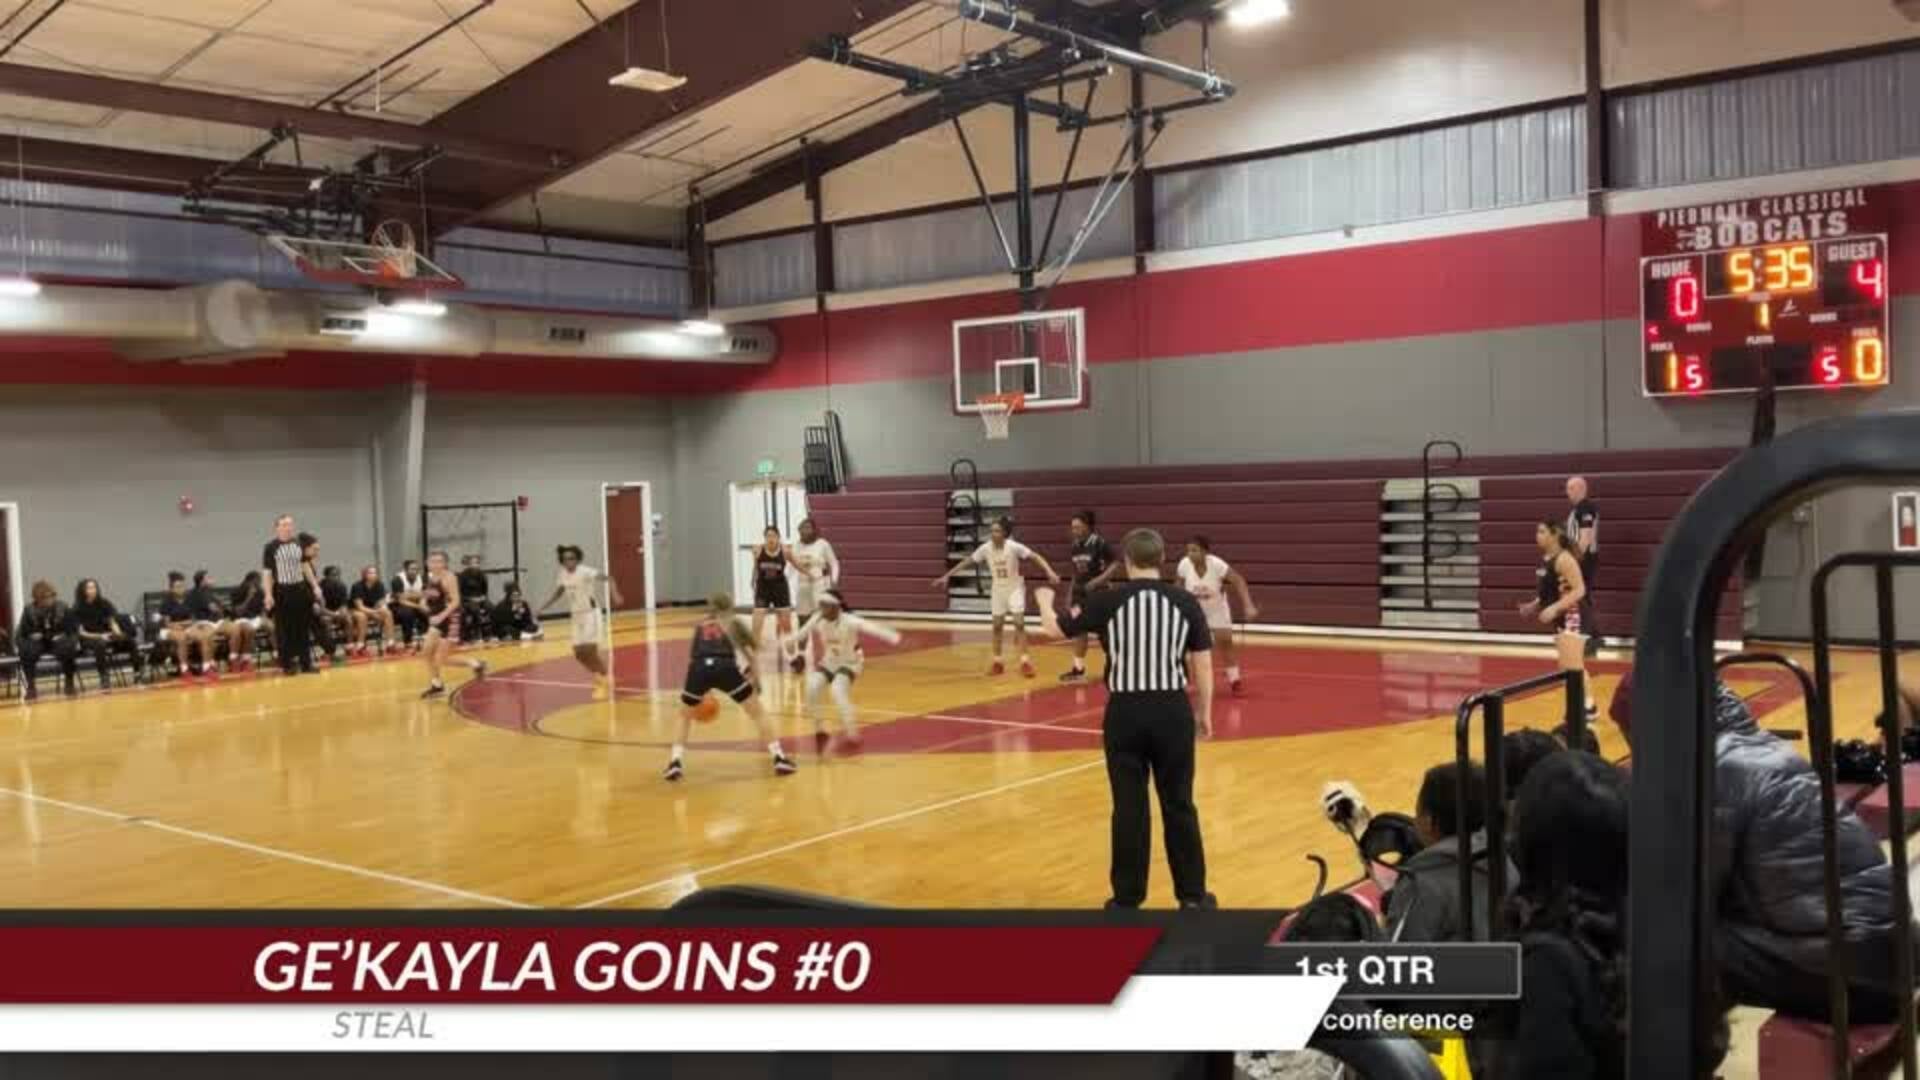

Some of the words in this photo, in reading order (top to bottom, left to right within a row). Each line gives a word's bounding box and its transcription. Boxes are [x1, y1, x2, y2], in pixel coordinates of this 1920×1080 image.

[1760, 188, 1866, 216] CLASSICAL
[1695, 210, 1848, 250] BOBCATS
[1651, 259, 1691, 279] HOME
[1729, 245, 1813, 293] 5:35
[1827, 241, 1878, 263] GUEST
[1675, 277, 1698, 317] 0
[1856, 261, 1882, 298] 4
[1759, 302, 1769, 328] 1
[1669, 352, 1678, 390] 1
[1855, 337, 1882, 381] 0
